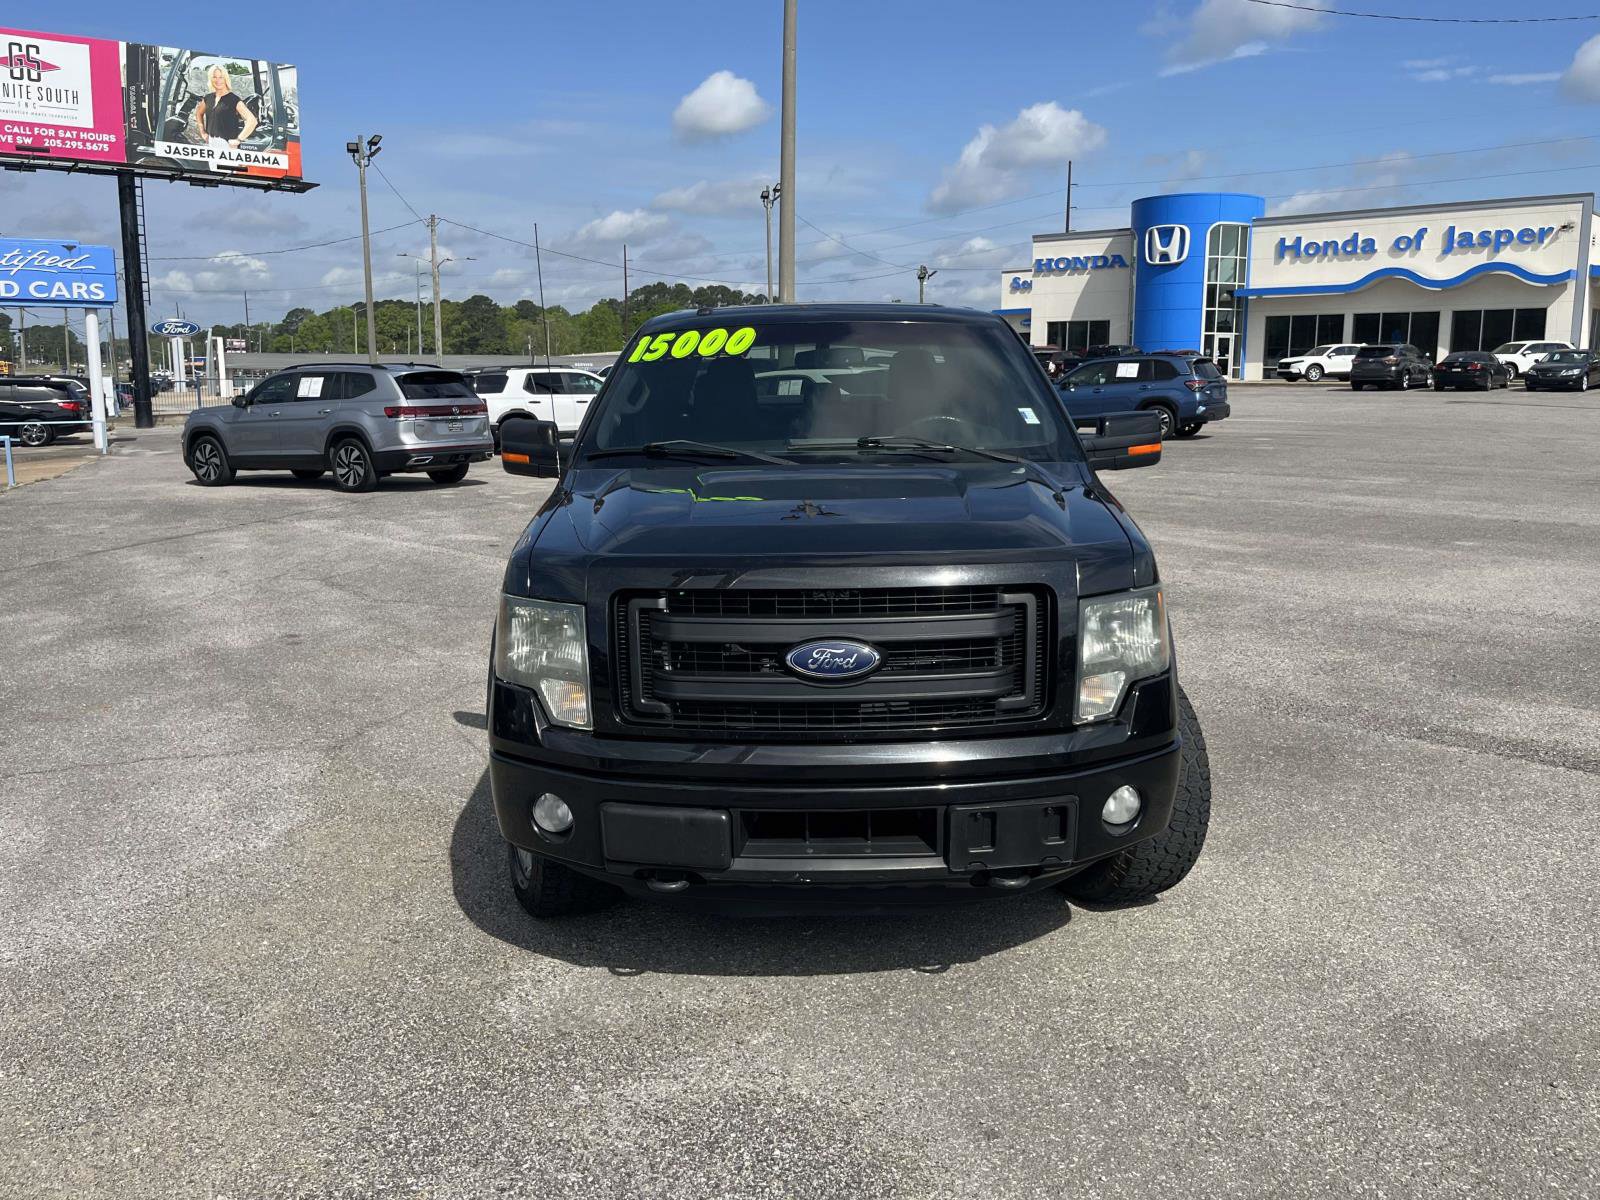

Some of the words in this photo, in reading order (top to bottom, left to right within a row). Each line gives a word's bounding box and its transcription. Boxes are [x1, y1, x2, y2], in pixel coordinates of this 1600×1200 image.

[8, 42, 42, 82] GS
[37, 86, 79, 105] SOUTH
[4, 124, 32, 135] CALL
[34, 127, 55, 137] FOR
[58, 130, 77, 139] SAT
[80, 132, 117, 143] HOURS
[16, 136, 33, 145] SW
[43, 138, 109, 152] 205.295.5675
[164, 145, 215, 159] JASPER
[219, 151, 280, 166] ALABAMA
[1279, 232, 1378, 259] Honda
[1394, 227, 1428, 251] of
[1441, 225, 1555, 255] Jasper
[1034, 254, 1129, 273] HONDA
[28, 280, 105, 300] CARS
[162, 322, 191, 334] Ford
[628, 327, 756, 363] 15000
[808, 648, 858, 669] Ford
